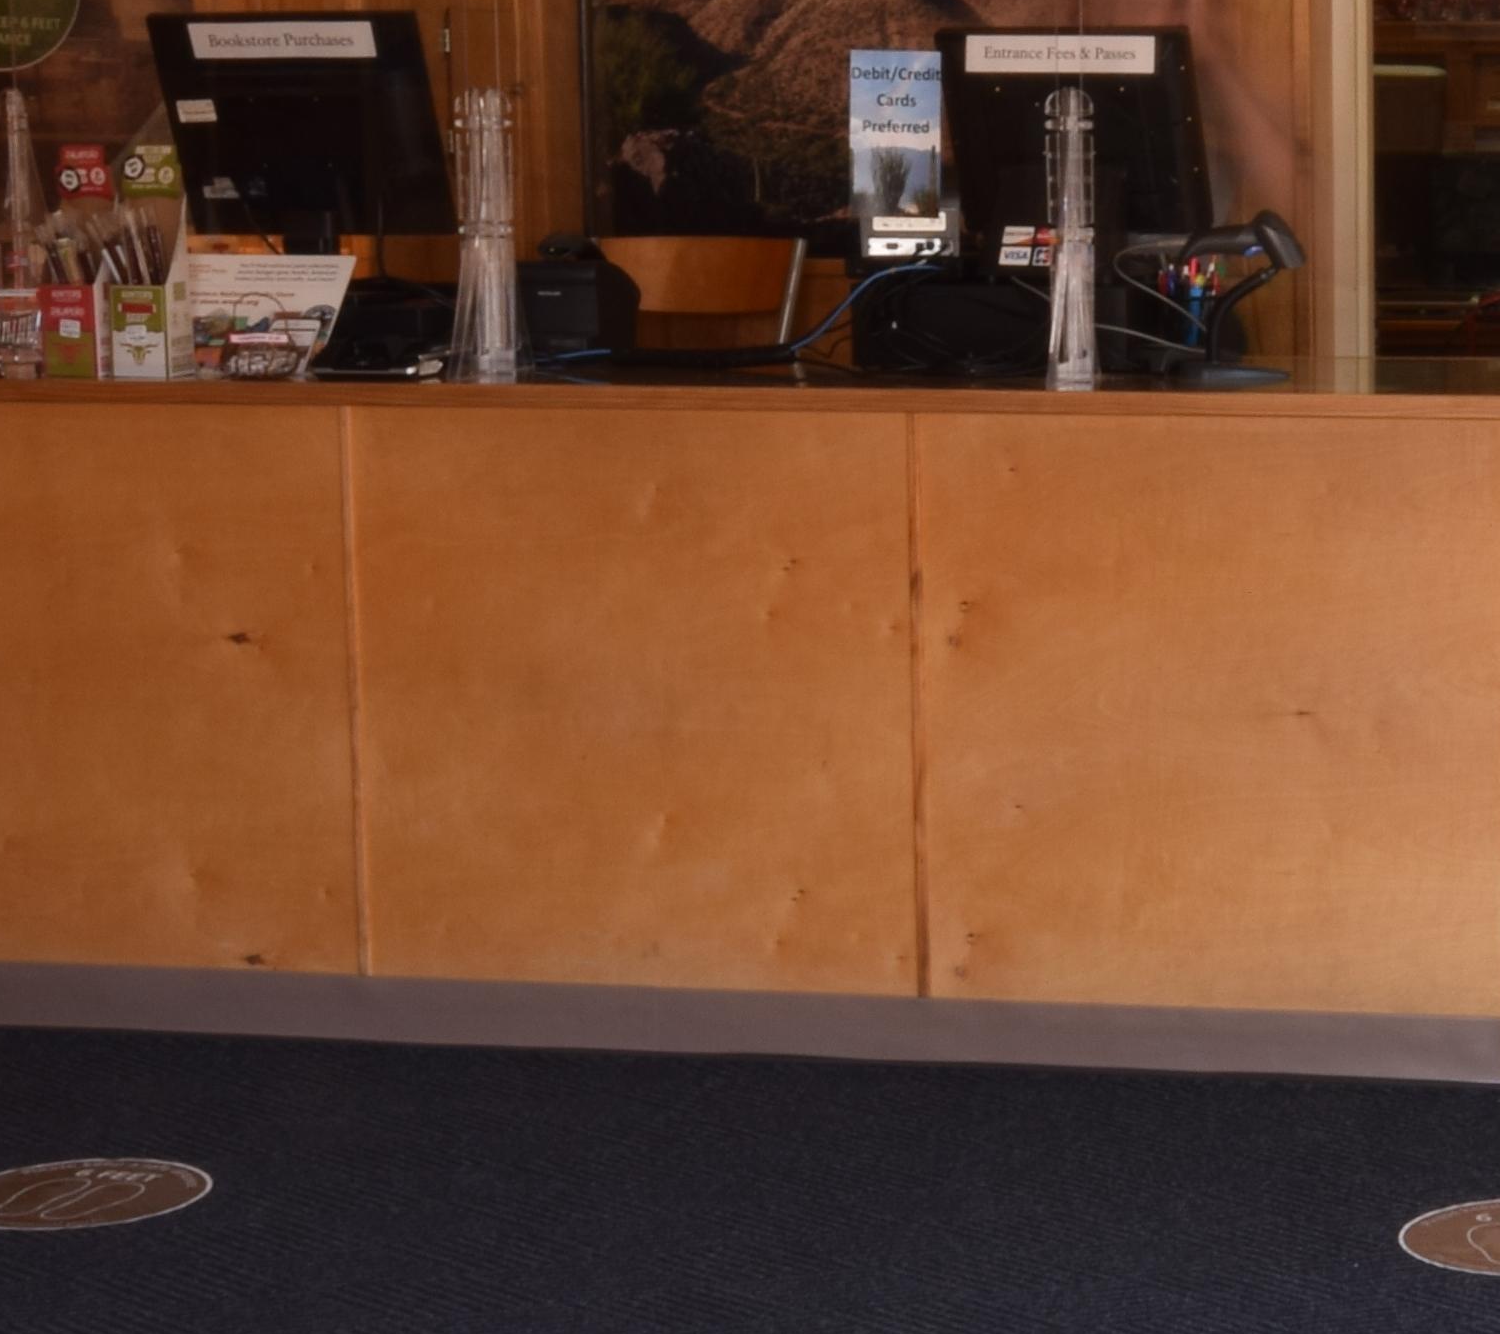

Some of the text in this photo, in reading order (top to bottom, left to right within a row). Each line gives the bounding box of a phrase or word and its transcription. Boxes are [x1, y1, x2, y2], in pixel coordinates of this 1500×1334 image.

[31, 16, 62, 30] FEET
[207, 32, 354, 49] Bookstore Purchases
[983, 45, 1137, 61] Entrance Fees & Passes
[850, 66, 942, 83] Debit/Credit
[875, 93, 917, 108] Cards
[861, 119, 931, 134] Preferred
[75, 1168, 95, 1177] 6
[97, 1169, 164, 1183] FEET
[1475, 1212, 1493, 1223] 6
